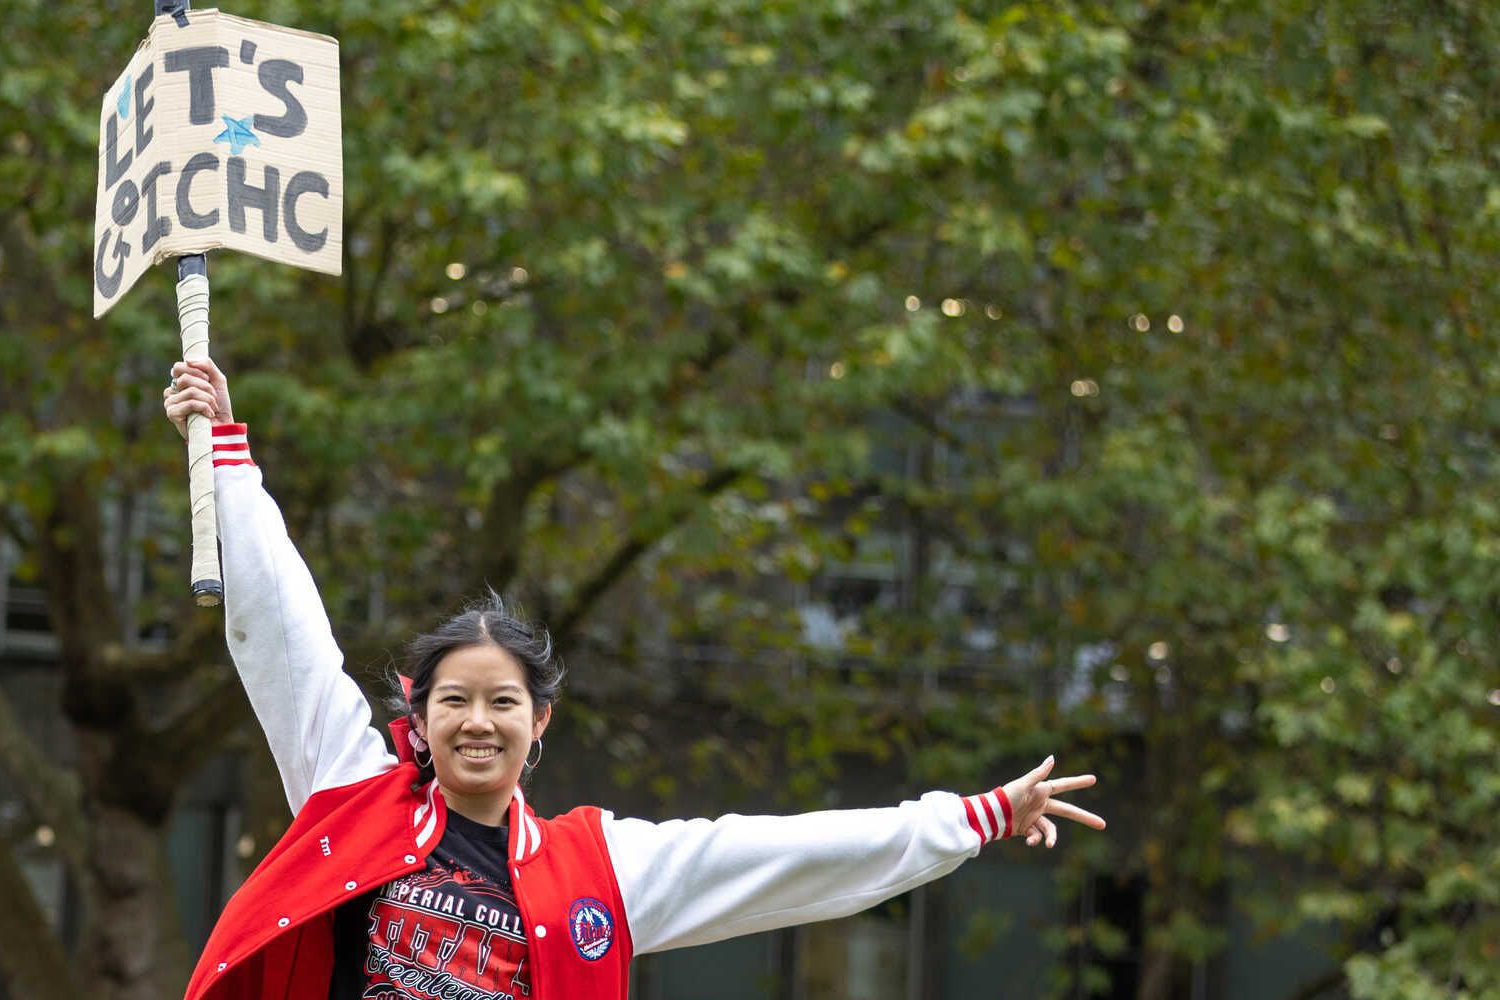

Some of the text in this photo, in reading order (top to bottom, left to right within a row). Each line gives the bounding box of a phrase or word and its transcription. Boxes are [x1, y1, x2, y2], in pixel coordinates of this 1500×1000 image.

[105, 40, 308, 190] LET'S
[96, 152, 330, 299] GO ICHC
